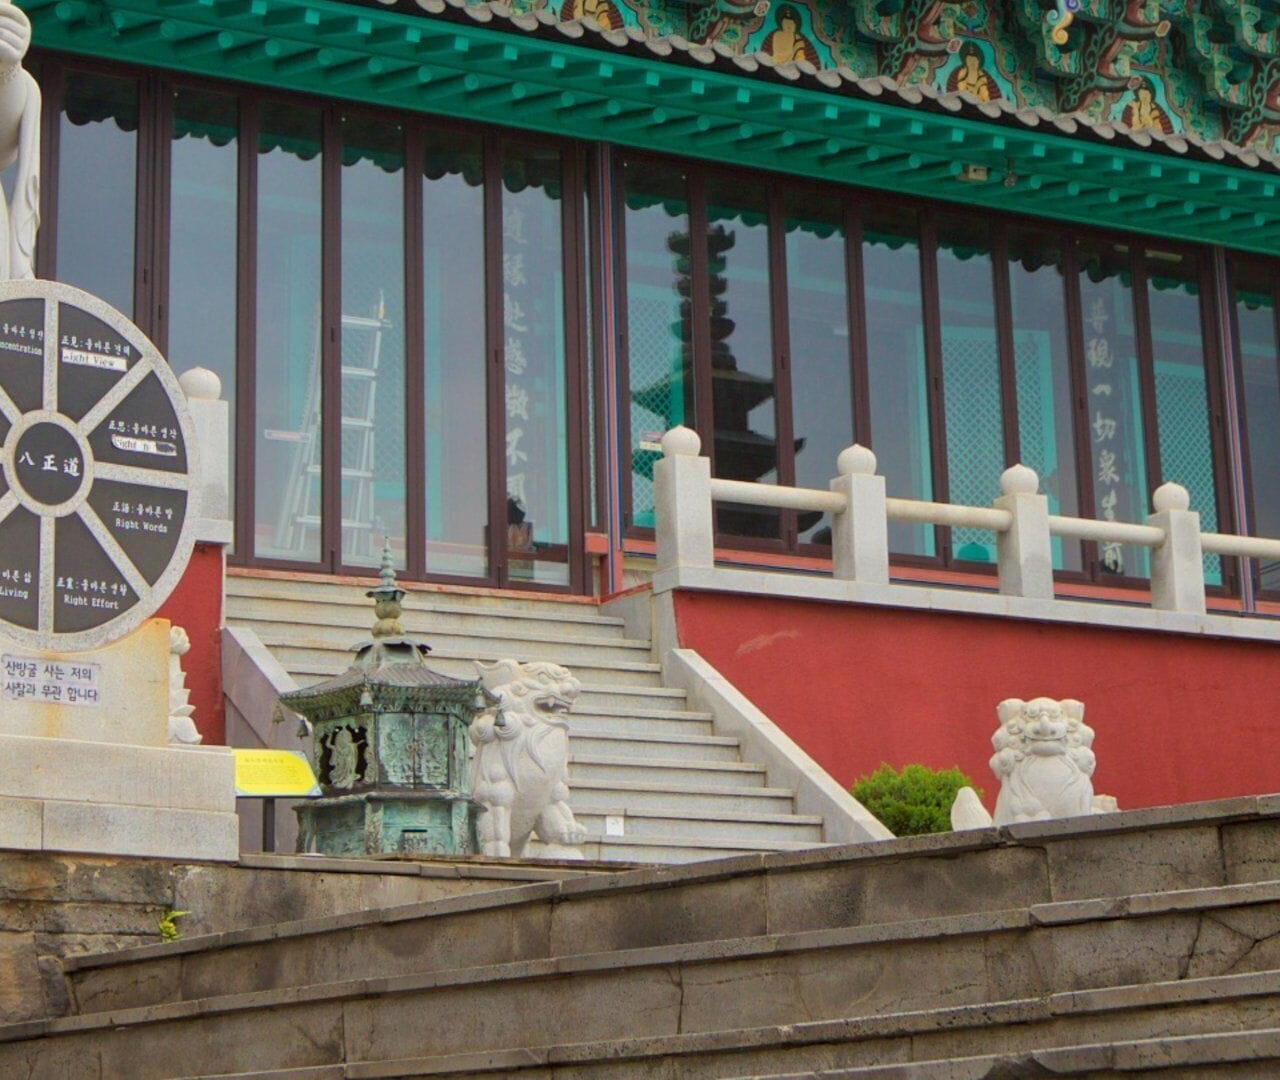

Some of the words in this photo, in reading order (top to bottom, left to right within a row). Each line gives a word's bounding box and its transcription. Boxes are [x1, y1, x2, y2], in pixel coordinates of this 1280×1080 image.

[18, 451, 80, 477] 八正道
[115, 517, 139, 530] Right
[143, 521, 168, 534] Words
[0, 585, 29, 600] Living
[63, 593, 88, 607] Right
[91, 597, 120, 611] Effort
[5, 681, 36, 698] 사찰과
[67, 687, 98, 702] 합니다
